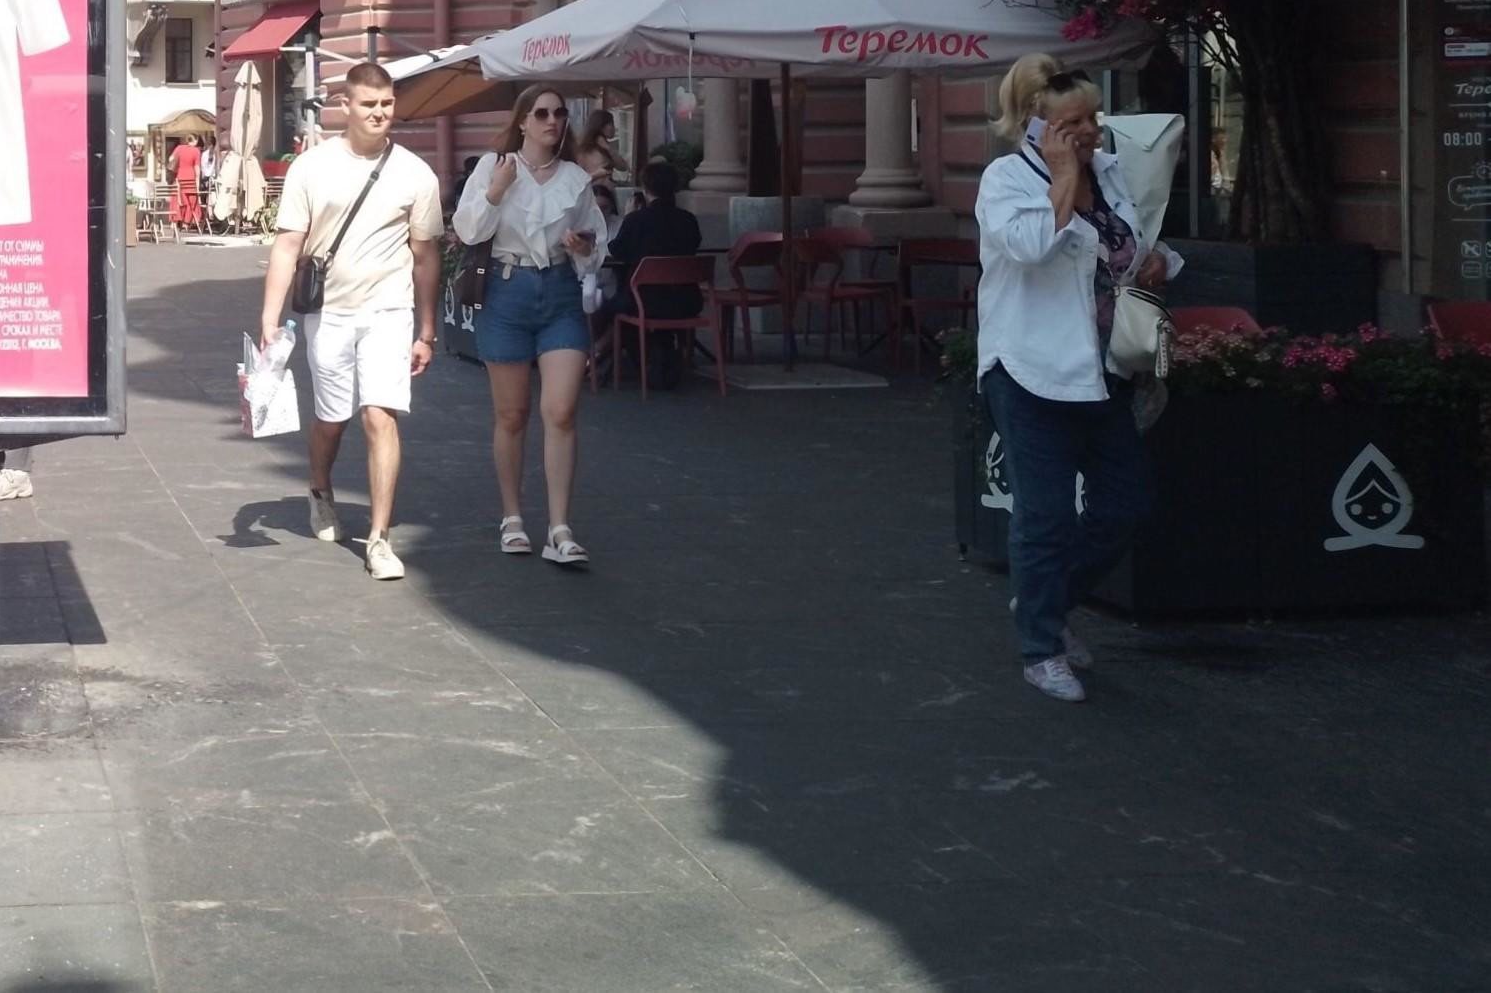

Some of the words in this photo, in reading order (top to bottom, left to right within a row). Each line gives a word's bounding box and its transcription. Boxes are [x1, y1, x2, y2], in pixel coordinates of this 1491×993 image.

[522, 33, 571, 66] Теремок
[814, 25, 990, 63] Теремок
[1443, 132, 1482, 146] 08:00
